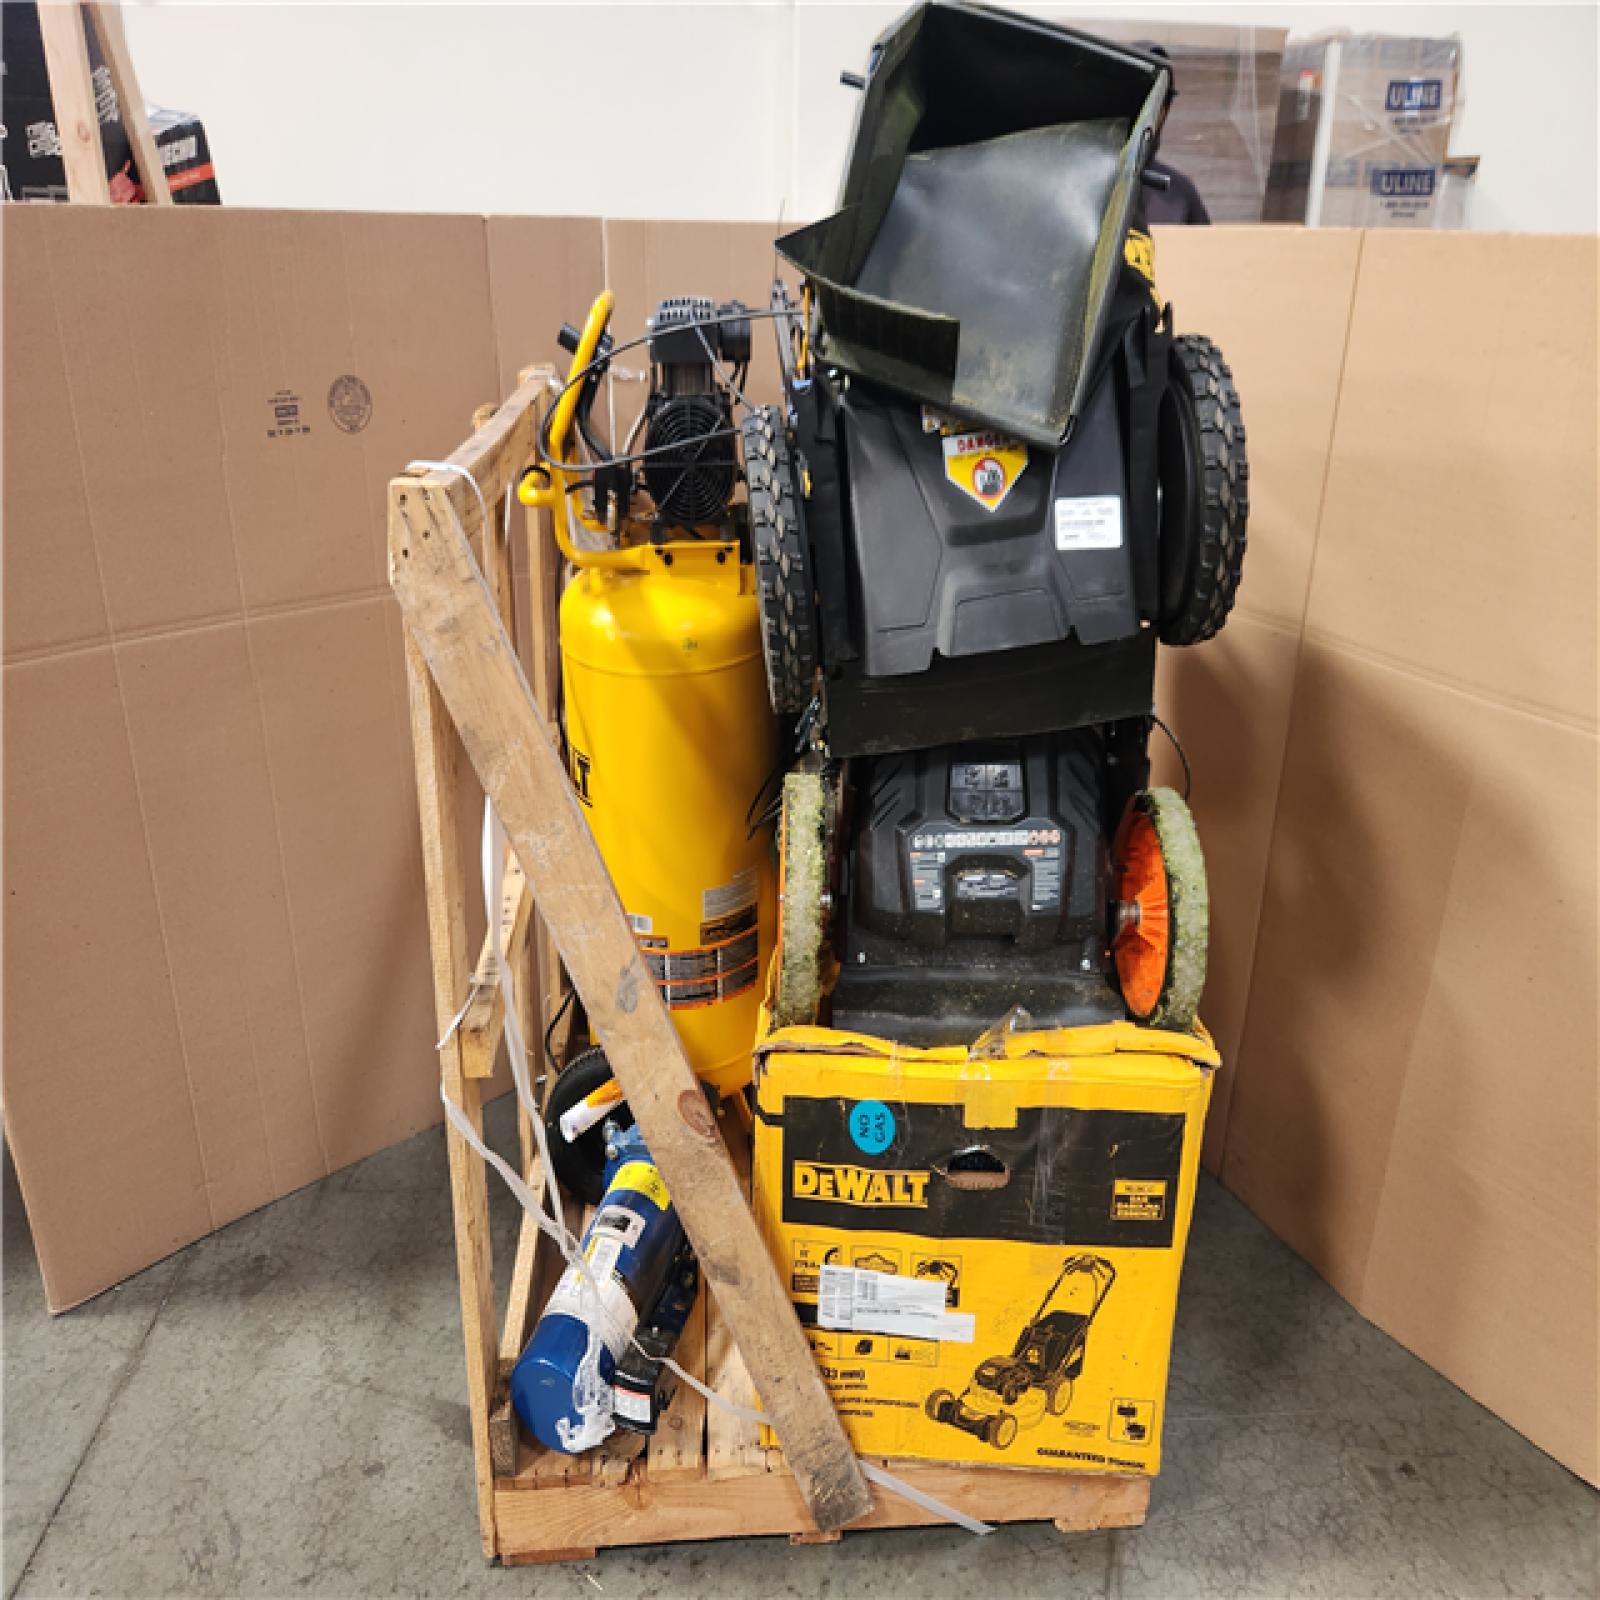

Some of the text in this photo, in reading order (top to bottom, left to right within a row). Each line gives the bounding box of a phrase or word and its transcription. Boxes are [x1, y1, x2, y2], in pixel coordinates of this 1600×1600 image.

[1380, 174, 1431, 193] ULINE
[859, 1114, 870, 1138] NO
[874, 1112, 886, 1143] GAS
[794, 1165, 930, 1204] DEWALT
